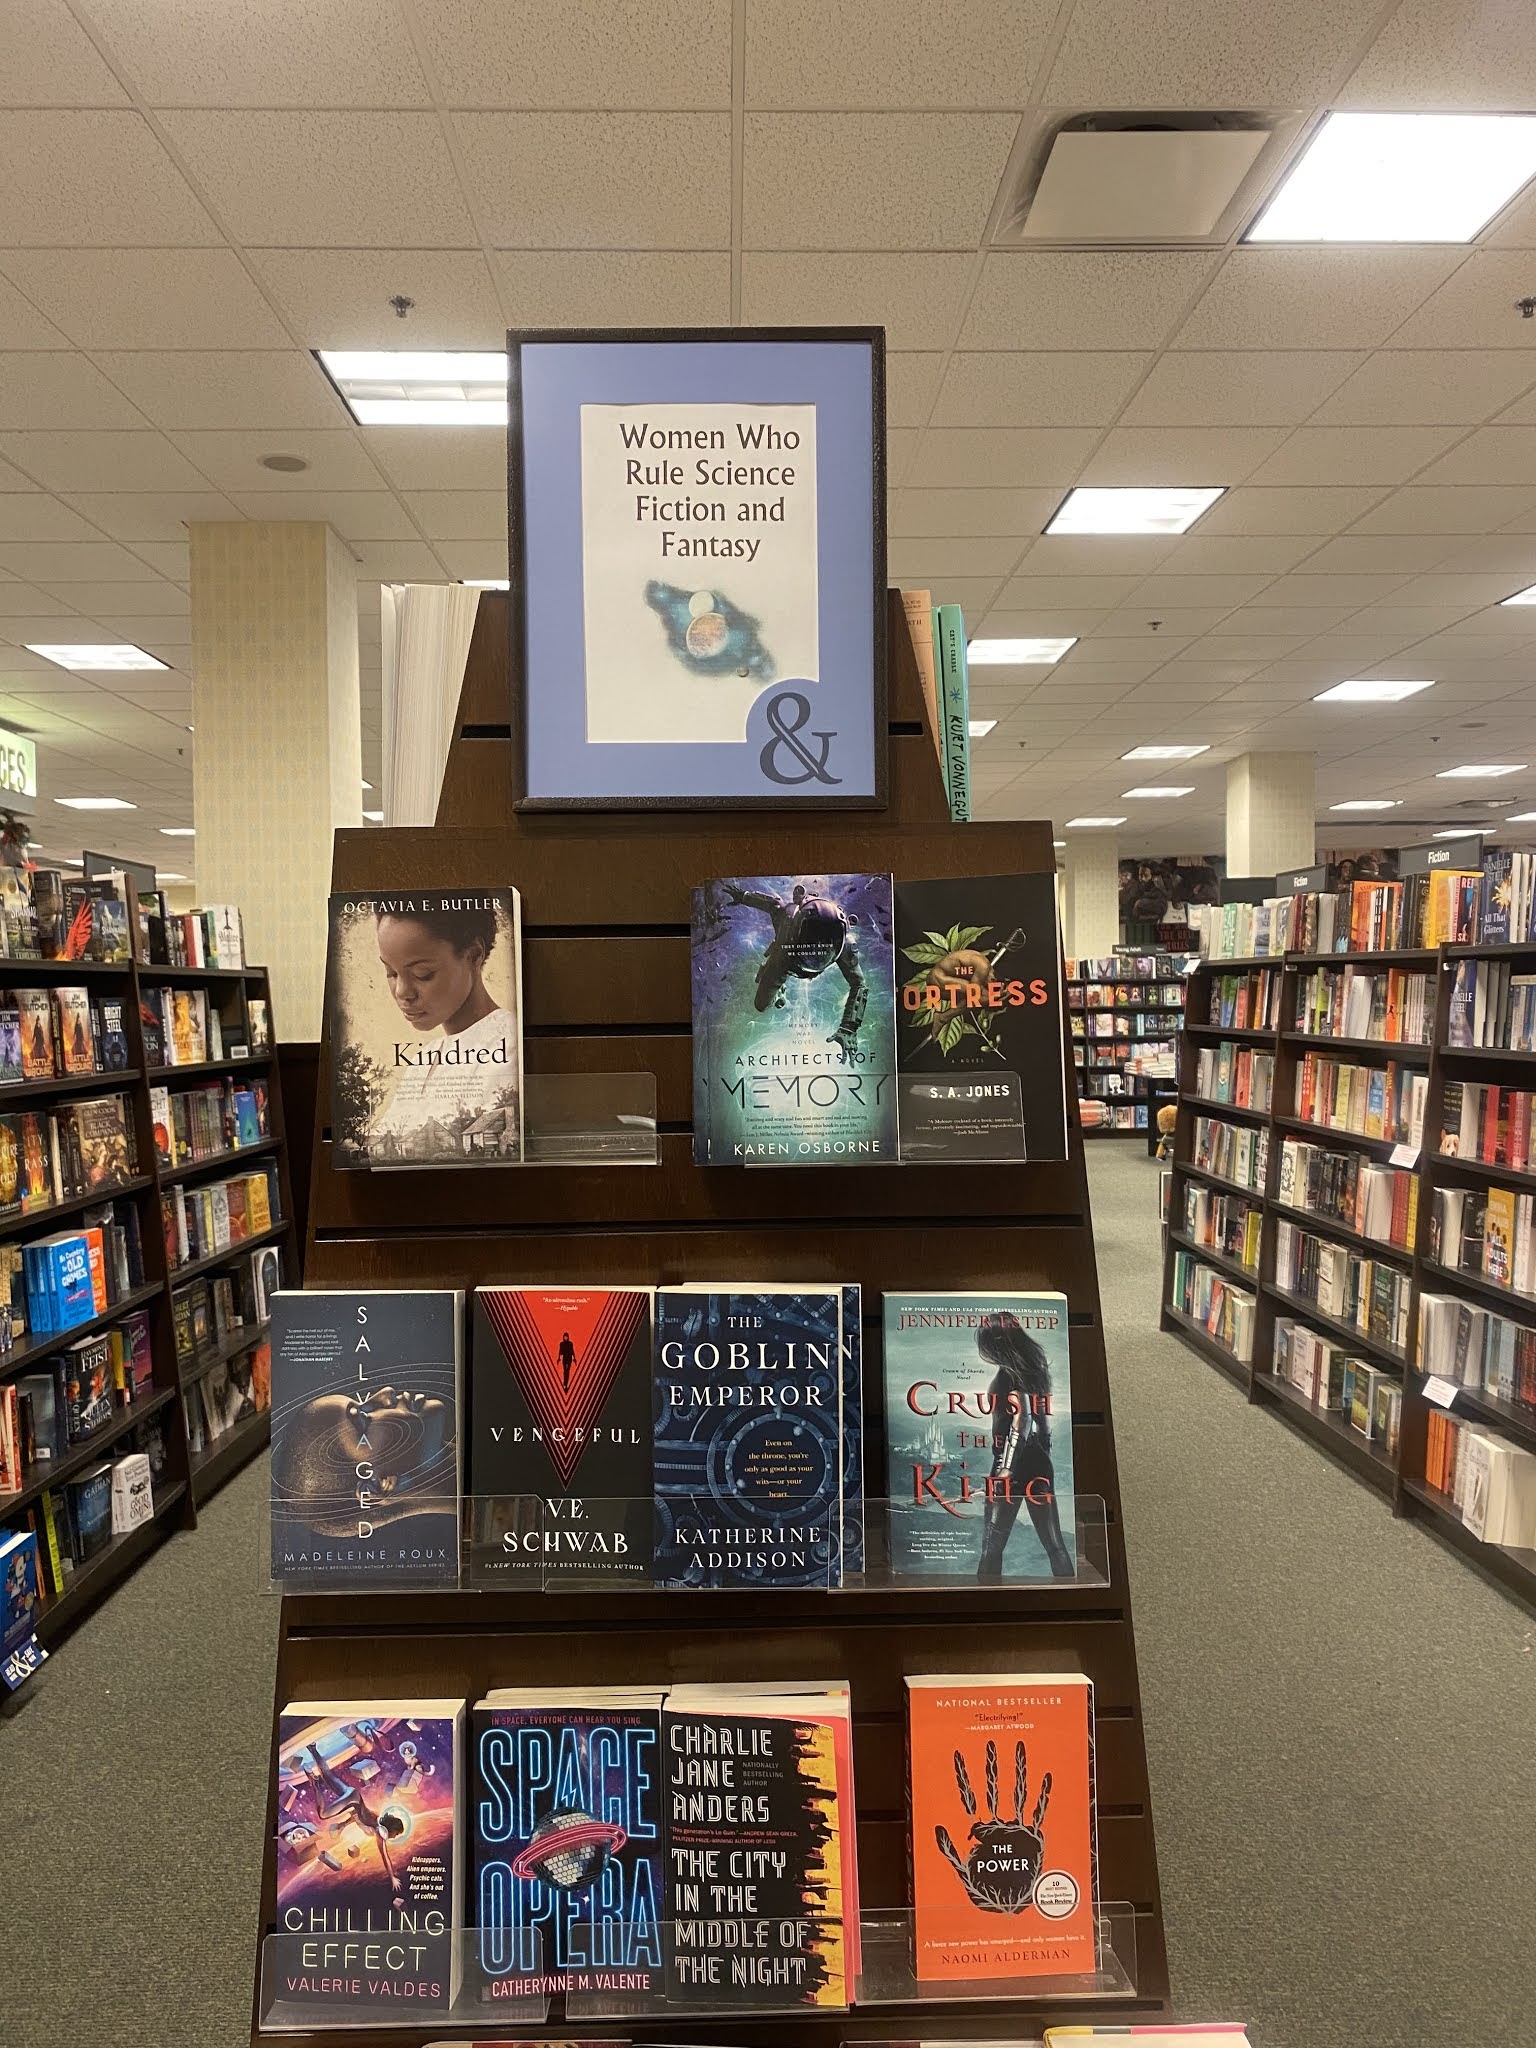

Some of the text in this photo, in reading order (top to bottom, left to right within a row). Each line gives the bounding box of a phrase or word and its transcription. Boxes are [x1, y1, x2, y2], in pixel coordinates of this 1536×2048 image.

[619, 423, 800, 450] Women Who
[626, 459, 795, 486] Rule Science
[635, 496, 785, 521] Fiction and
[661, 531, 760, 562] Fantasy
[949, 714, 964, 752] KURT
[1428, 850, 1450, 863] Fiction
[1484, 859, 1511, 872] DANIELLE
[1293, 876, 1308, 887] Fiction
[344, 898, 502, 914] OCTAVIA E. BUTLER
[1493, 914, 1506, 922] That
[954, 965, 973, 976] THE
[897, 979, 1048, 1011] ORTRESS
[392, 1038, 510, 1068] Kindred
[735, 1052, 877, 1066] ARCHITECTS OF
[720, 1074, 889, 1109] MEMORY
[930, 1085, 1010, 1099] S. A. JONES
[99, 1107, 116, 1115] COOK
[734, 1141, 880, 1156] KAREN OSBORNE
[67, 1256, 84, 1272] OLD
[61, 1267, 88, 1287] GNOMES
[727, 1316, 762, 1328] THE
[897, 1314, 1059, 1331] JENNIFER ESTEP
[661, 1342, 832, 1370] GOBLIN
[669, 1385, 823, 1407] EMPEROR
[355, 1306, 374, 1539] SALVAGED
[490, 1427, 641, 1444] VENGEFUL
[788, 1452, 809, 1460] you're
[744, 1466, 759, 1474] only
[769, 1465, 788, 1473] good
[547, 1498, 589, 1519] V.E.
[502, 1531, 628, 1553] SCHWAB
[675, 1527, 822, 1544] KATHERINE
[284, 1549, 445, 1562] MADELEINE ROUX
[689, 1551, 806, 1568] ADDISON
[936, 1697, 1061, 1707] NATIONAL BESTSELLER
[502, 1717, 527, 1725] SPACE,
[529, 1716, 566, 1724] EVERYONE
[607, 1716, 621, 1724] YOU
[670, 1723, 774, 1757] CHARLIE
[671, 1757, 735, 1788] JANE
[480, 1728, 656, 1842] SPACE
[671, 1791, 769, 1823] ANDERS
[992, 1844, 1013, 1854] THE
[411, 1856, 442, 1864] Kidnappers.
[671, 1848, 786, 1882] THE CITY
[977, 1857, 1030, 1873] POWER
[410, 1874, 430, 1882] Psychic
[675, 1883, 757, 1913] IN THE
[284, 1907, 445, 1936] CHILLING
[480, 1858, 662, 1975] OPERA
[674, 1919, 812, 1949] MIDDLE OF
[302, 1943, 426, 1970] EFFECT
[941, 1949, 1071, 1964] NAOMI ALDERMAN
[674, 1954, 807, 1988] THE NIGHT
[286, 1977, 440, 1998] VALERIE VALDES
[492, 1974, 650, 1997] CATHERYNNE M. VALENTE
